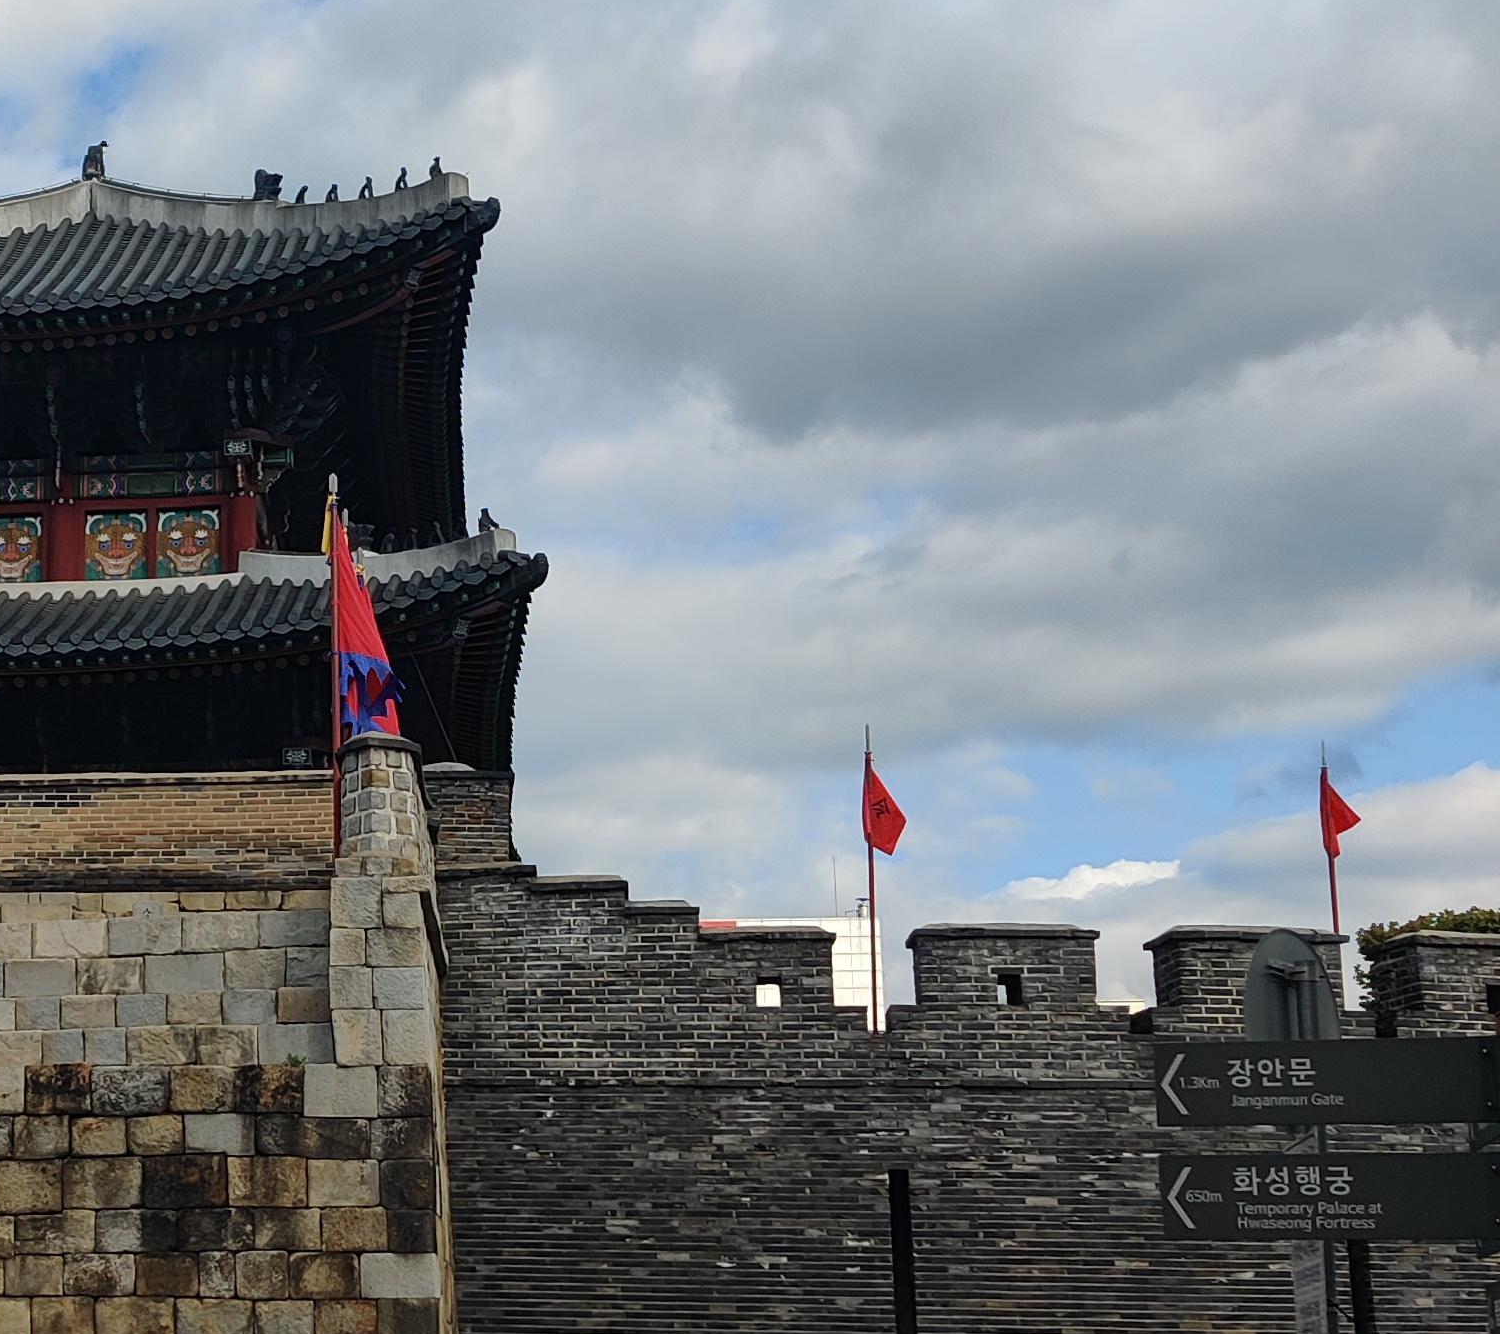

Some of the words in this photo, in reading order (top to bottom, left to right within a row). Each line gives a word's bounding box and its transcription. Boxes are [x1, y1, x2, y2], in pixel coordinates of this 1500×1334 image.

[1227, 1058, 1317, 1087] 장안문
[1231, 1094, 1308, 1109] Janganmun
[1311, 1092, 1345, 1106] Gate
[1232, 1166, 1354, 1196] 화성행궁
[1185, 1190, 1223, 1203] 650m
[1236, 1202, 1314, 1217] Temporary
[1318, 1202, 1365, 1215] Palace
[1368, 1202, 1383, 1214] at
[1237, 1217, 1312, 1232] Hwaseong
[1315, 1217, 1376, 1229] Fortress
